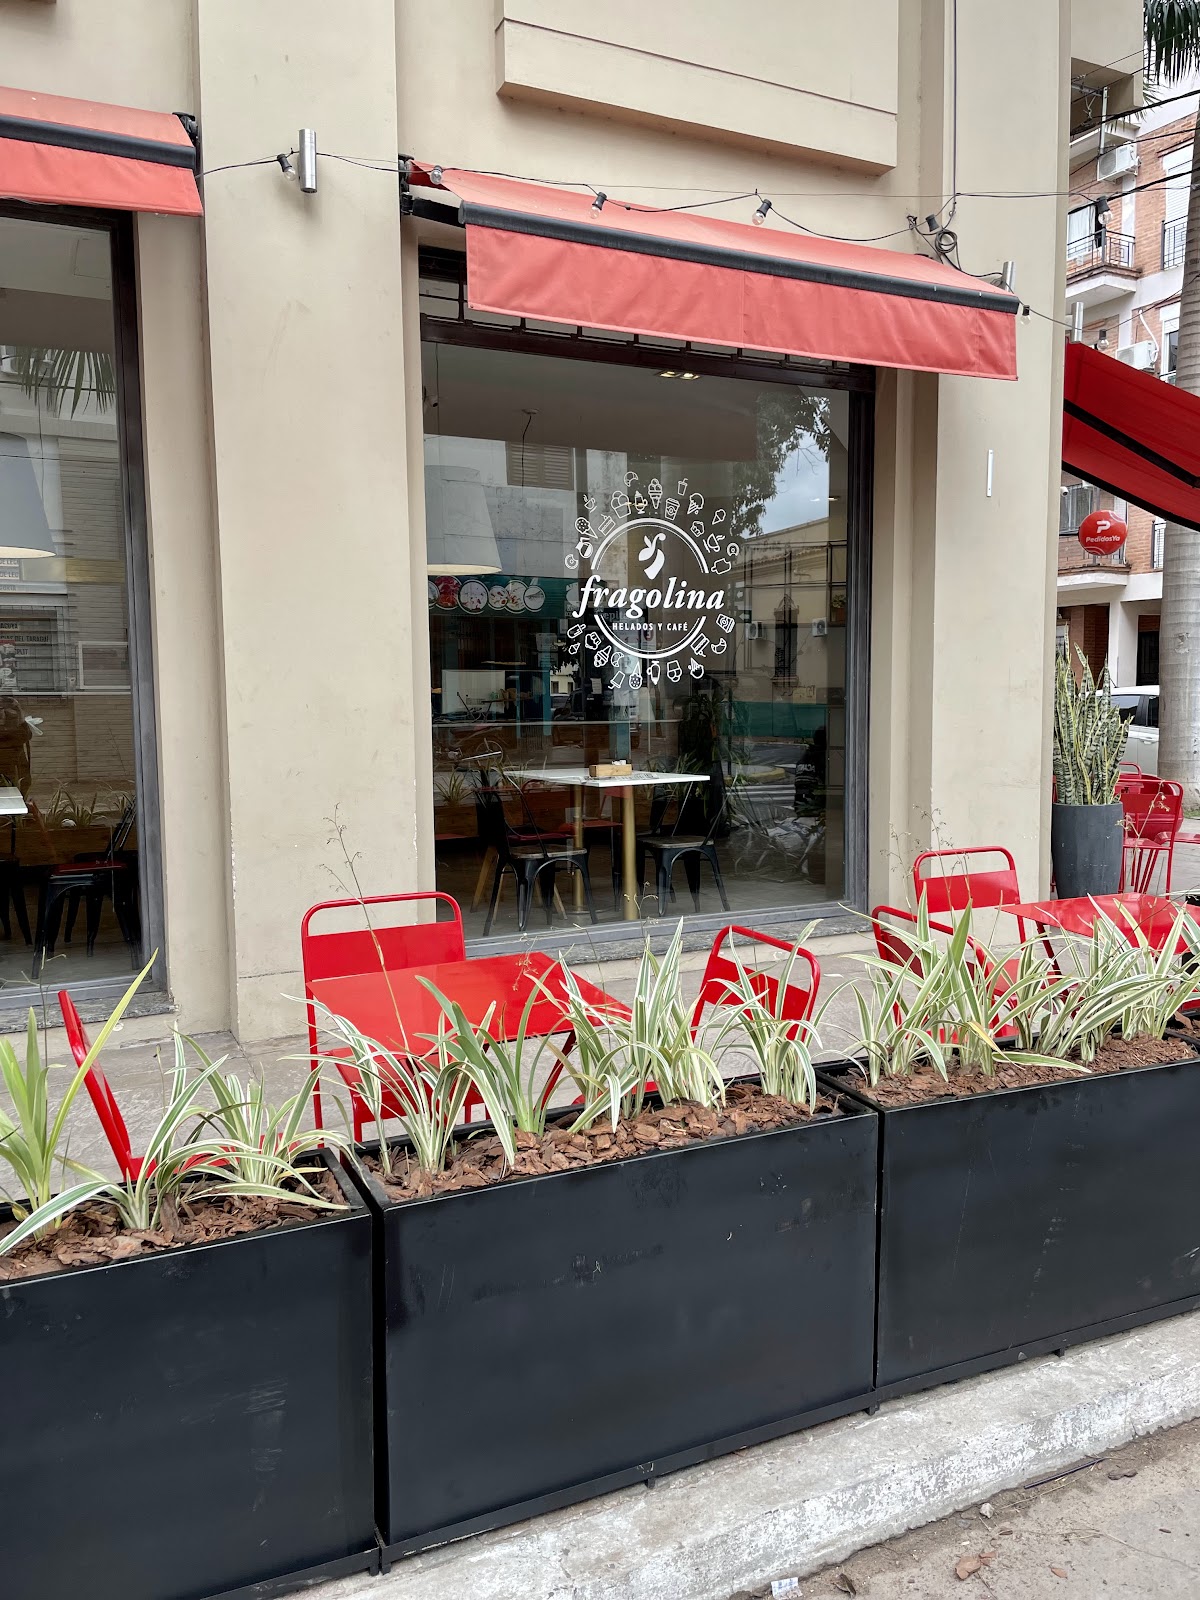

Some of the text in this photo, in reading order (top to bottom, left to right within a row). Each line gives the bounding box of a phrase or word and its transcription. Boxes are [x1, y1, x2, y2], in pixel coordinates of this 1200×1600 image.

[1086, 535, 1121, 543] PedidosYa
[572, 574, 725, 618] fragolina
[612, 621, 688, 631] HELADOS Y CAFÉ
